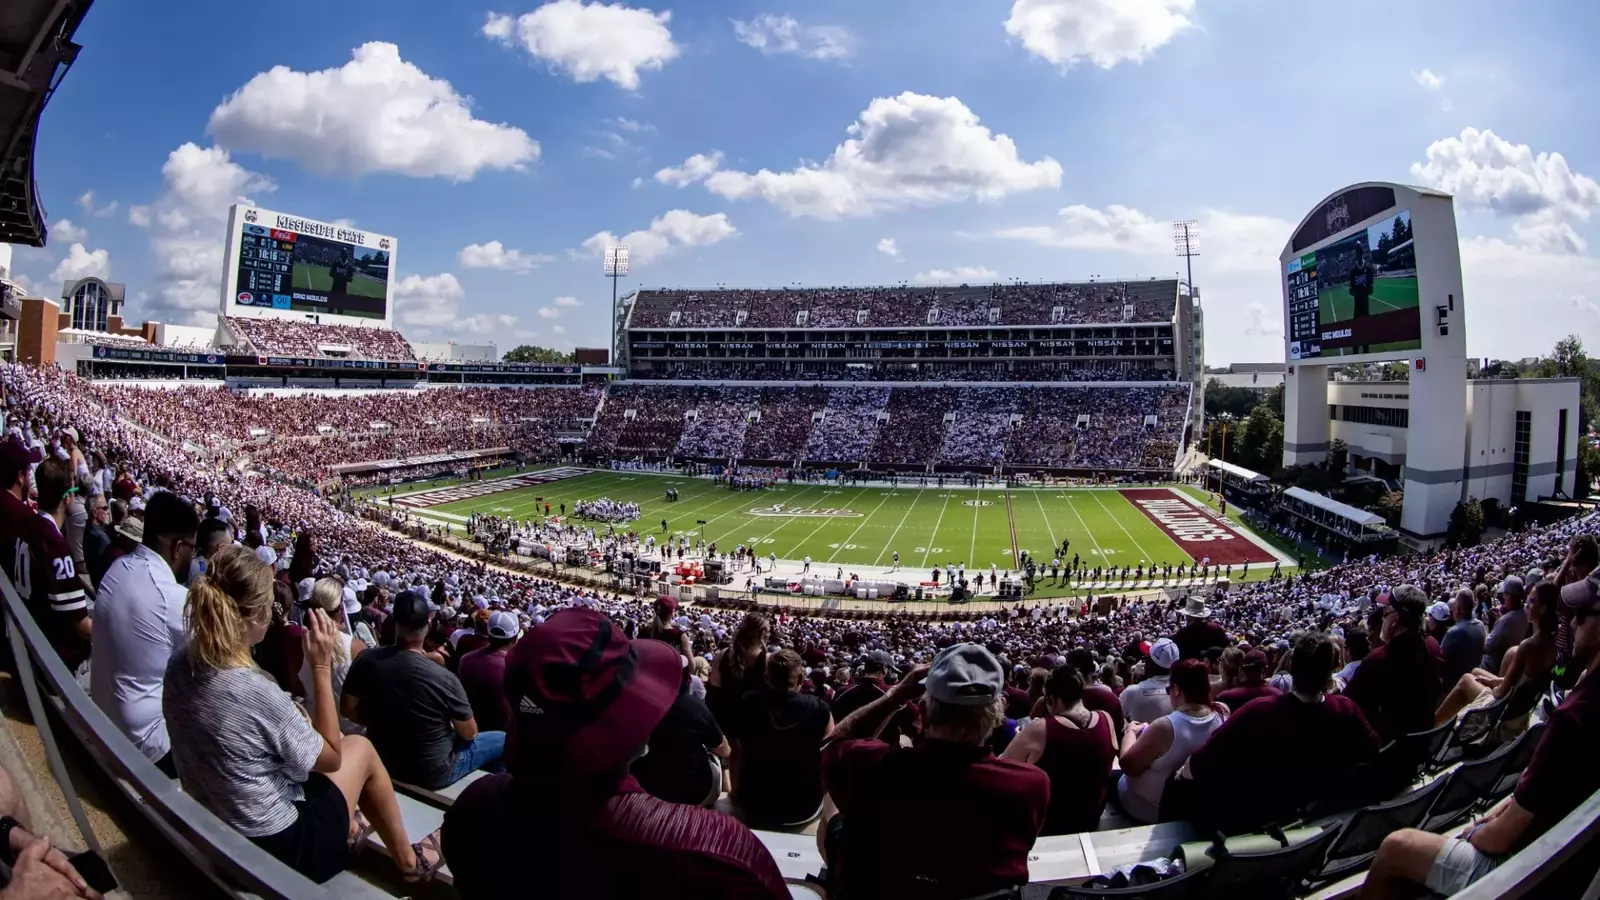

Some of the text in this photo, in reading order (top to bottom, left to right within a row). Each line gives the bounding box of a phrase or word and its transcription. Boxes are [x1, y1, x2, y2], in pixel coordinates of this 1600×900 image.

[276, 214, 335, 238] MISSISSIPPI
[337, 228, 365, 244] STATE
[259, 249, 278, 261] 10:16
[293, 292, 328, 303] ERIC MOULDS
[1321, 328, 1352, 341] ERIC MOULDS
[1136, 499, 1235, 542] BULLDOGS
[53, 555, 75, 580] 20
